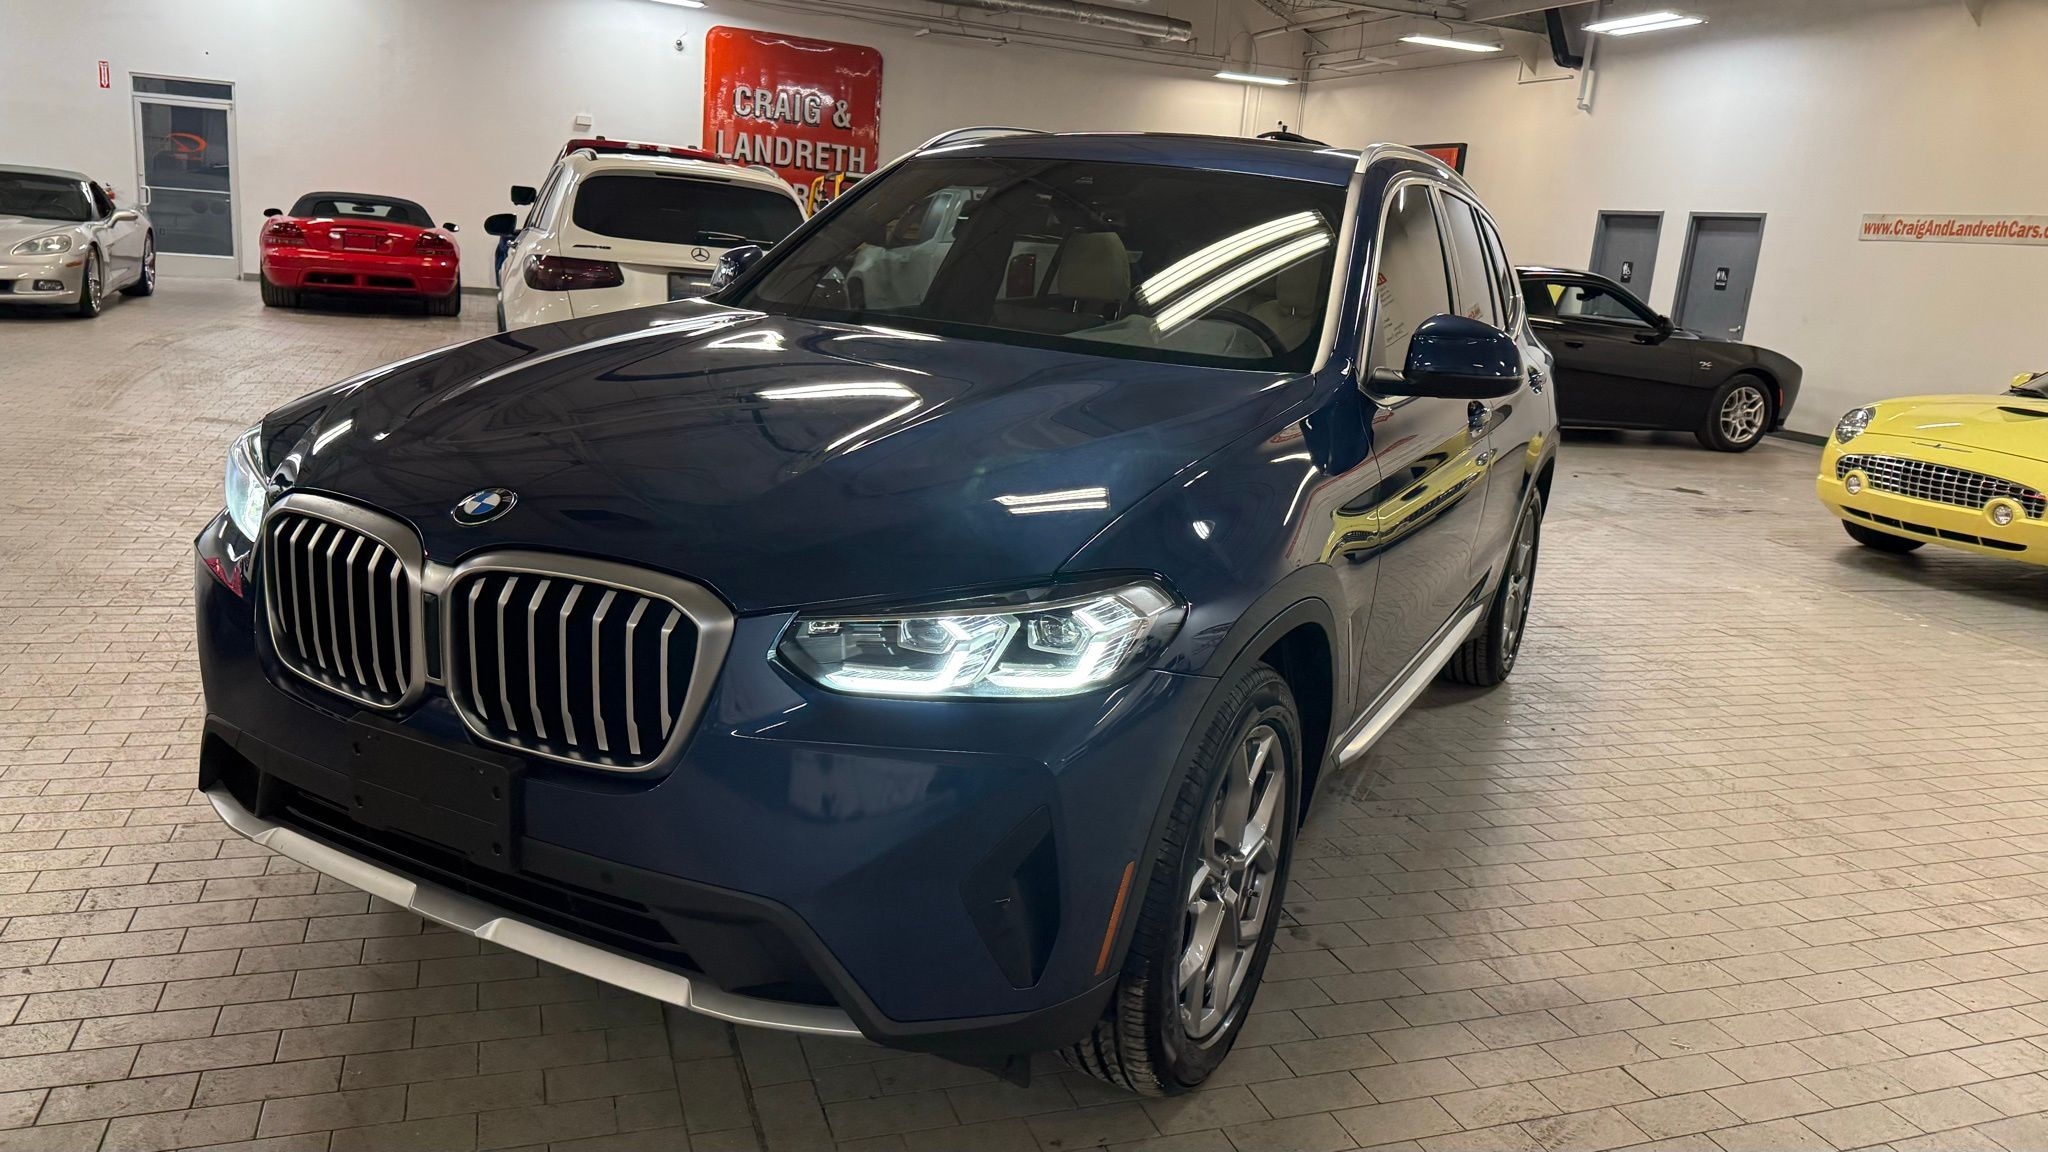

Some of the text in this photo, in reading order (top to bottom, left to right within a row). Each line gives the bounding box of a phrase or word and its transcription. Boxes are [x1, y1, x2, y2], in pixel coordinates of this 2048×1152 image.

[734, 86, 852, 129] CRAIG &
[717, 129, 866, 173] LANDRETH
